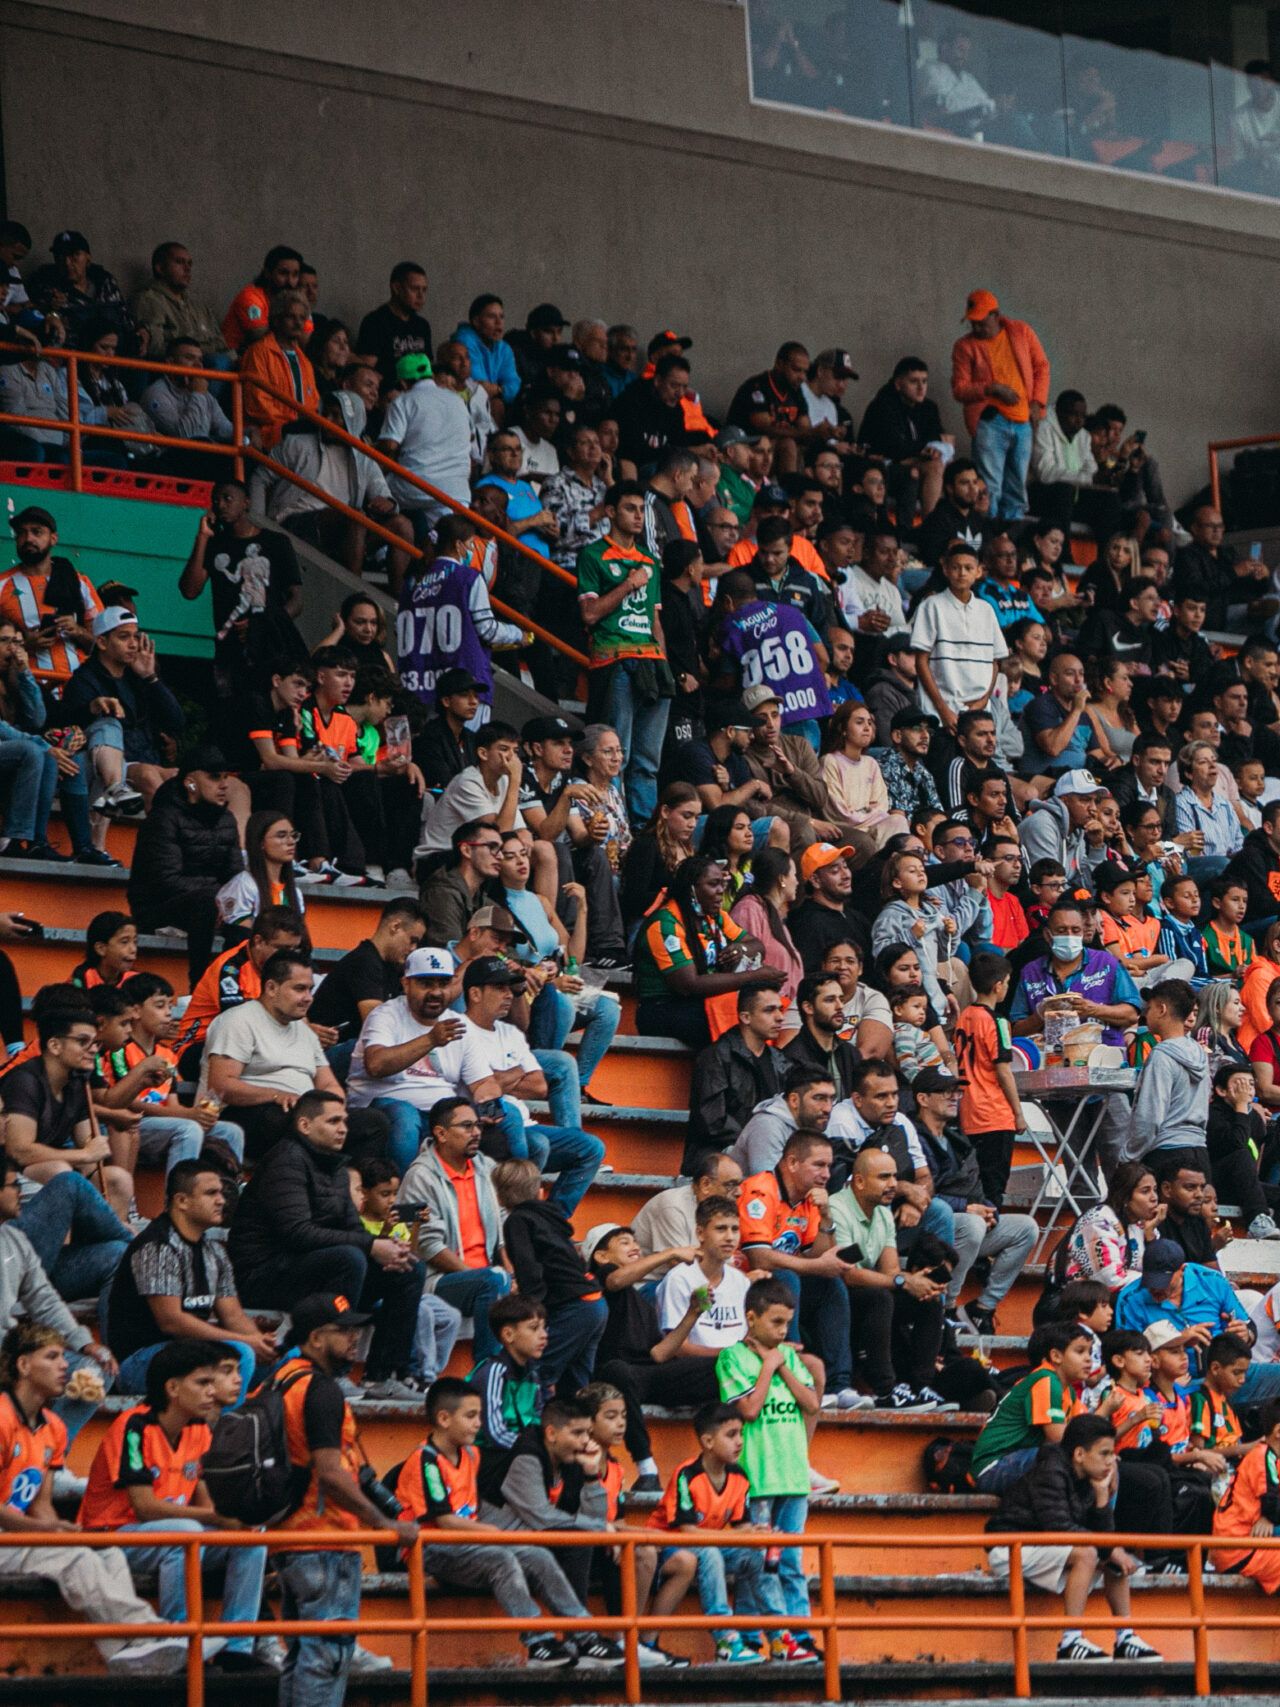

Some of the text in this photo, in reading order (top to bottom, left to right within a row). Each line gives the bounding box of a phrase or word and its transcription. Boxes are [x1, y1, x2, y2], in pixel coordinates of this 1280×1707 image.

[396, 604, 462, 657] 070
[400, 667, 452, 692] $3.0
[707, 1306, 738, 1321] MIRI
